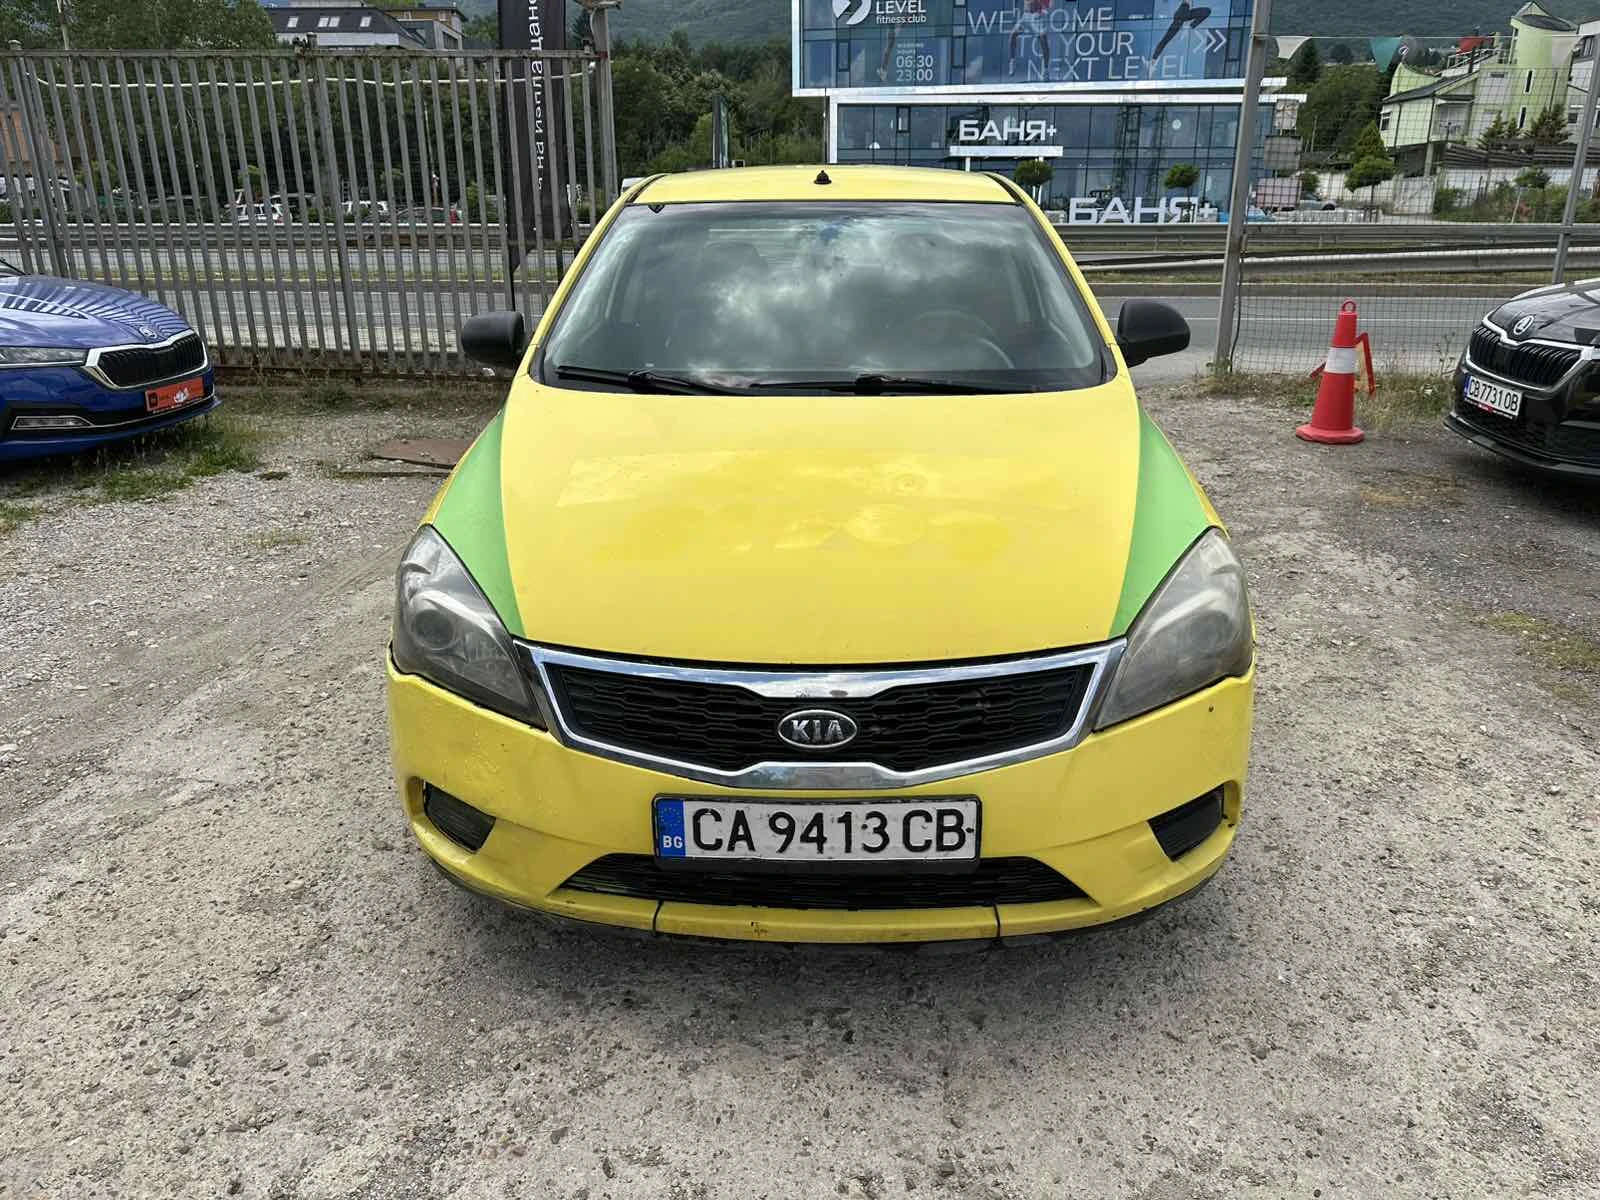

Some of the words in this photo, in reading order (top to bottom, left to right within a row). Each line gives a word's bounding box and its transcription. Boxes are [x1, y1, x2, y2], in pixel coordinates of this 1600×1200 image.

[876, 0, 927, 14] LEVEL
[876, 15, 906, 24] fitness
[907, 14, 927, 23] club
[1060, 31, 1134, 56] YOUR
[895, 55, 934, 68] 06:30
[1027, 57, 1099, 81] NEXT
[1108, 55, 1193, 80] LEVEL
[895, 69, 934, 81] 23:00
[791, 719, 844, 741] KIA
[692, 808, 756, 852] CA
[768, 811, 890, 854] 9413
[902, 808, 967, 853] CB
[662, 835, 683, 849] BG
